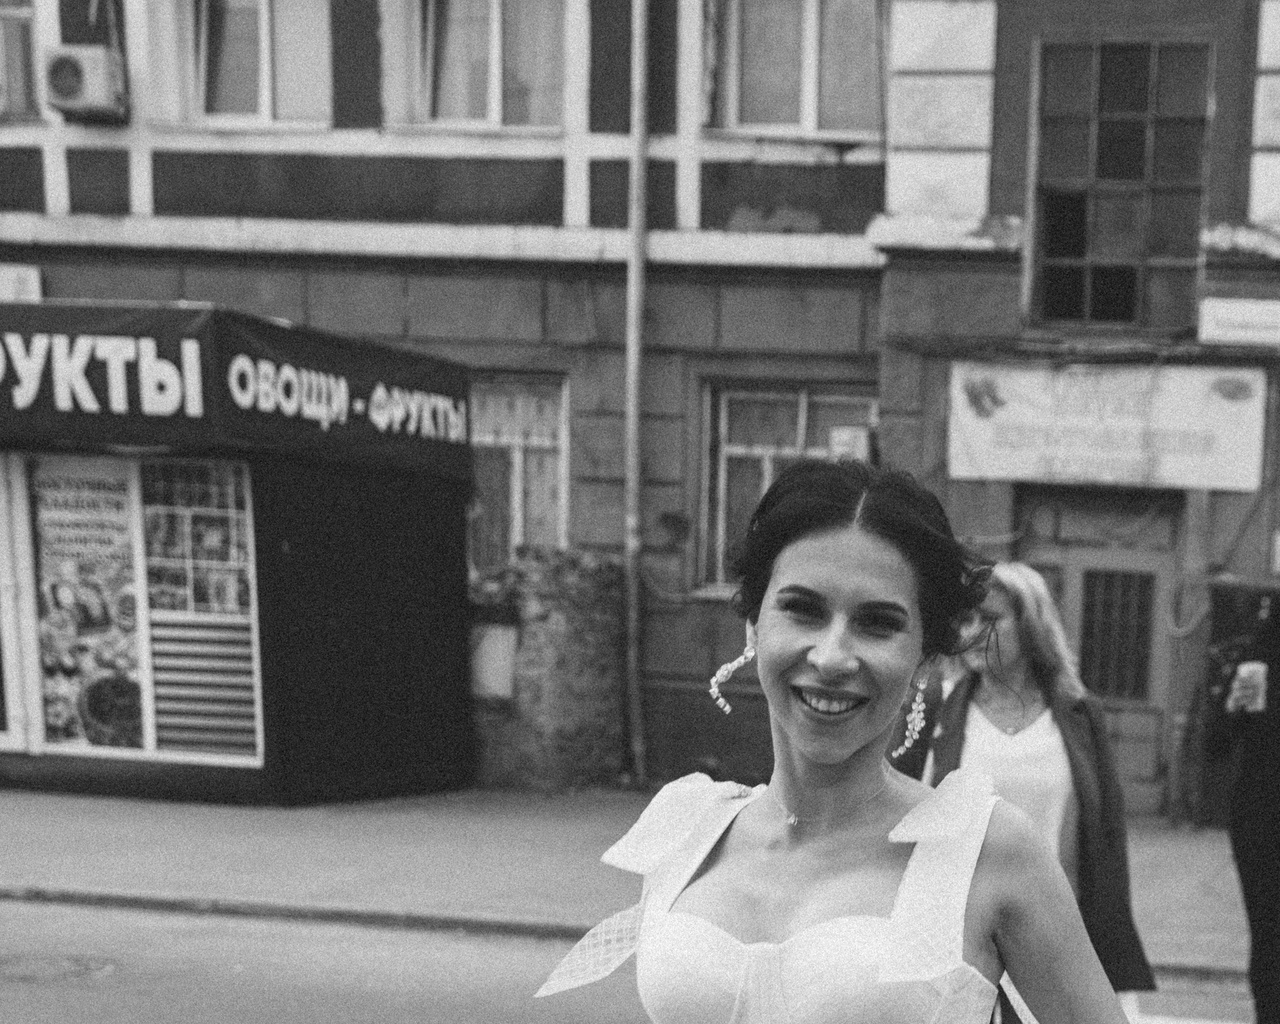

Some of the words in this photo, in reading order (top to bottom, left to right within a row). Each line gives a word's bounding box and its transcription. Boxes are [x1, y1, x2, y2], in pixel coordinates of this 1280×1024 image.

[0, 332, 203, 417] УКТЫ
[228, 354, 349, 431] ОВОЩИ
[368, 381, 467, 443] ФРУКТЫ
